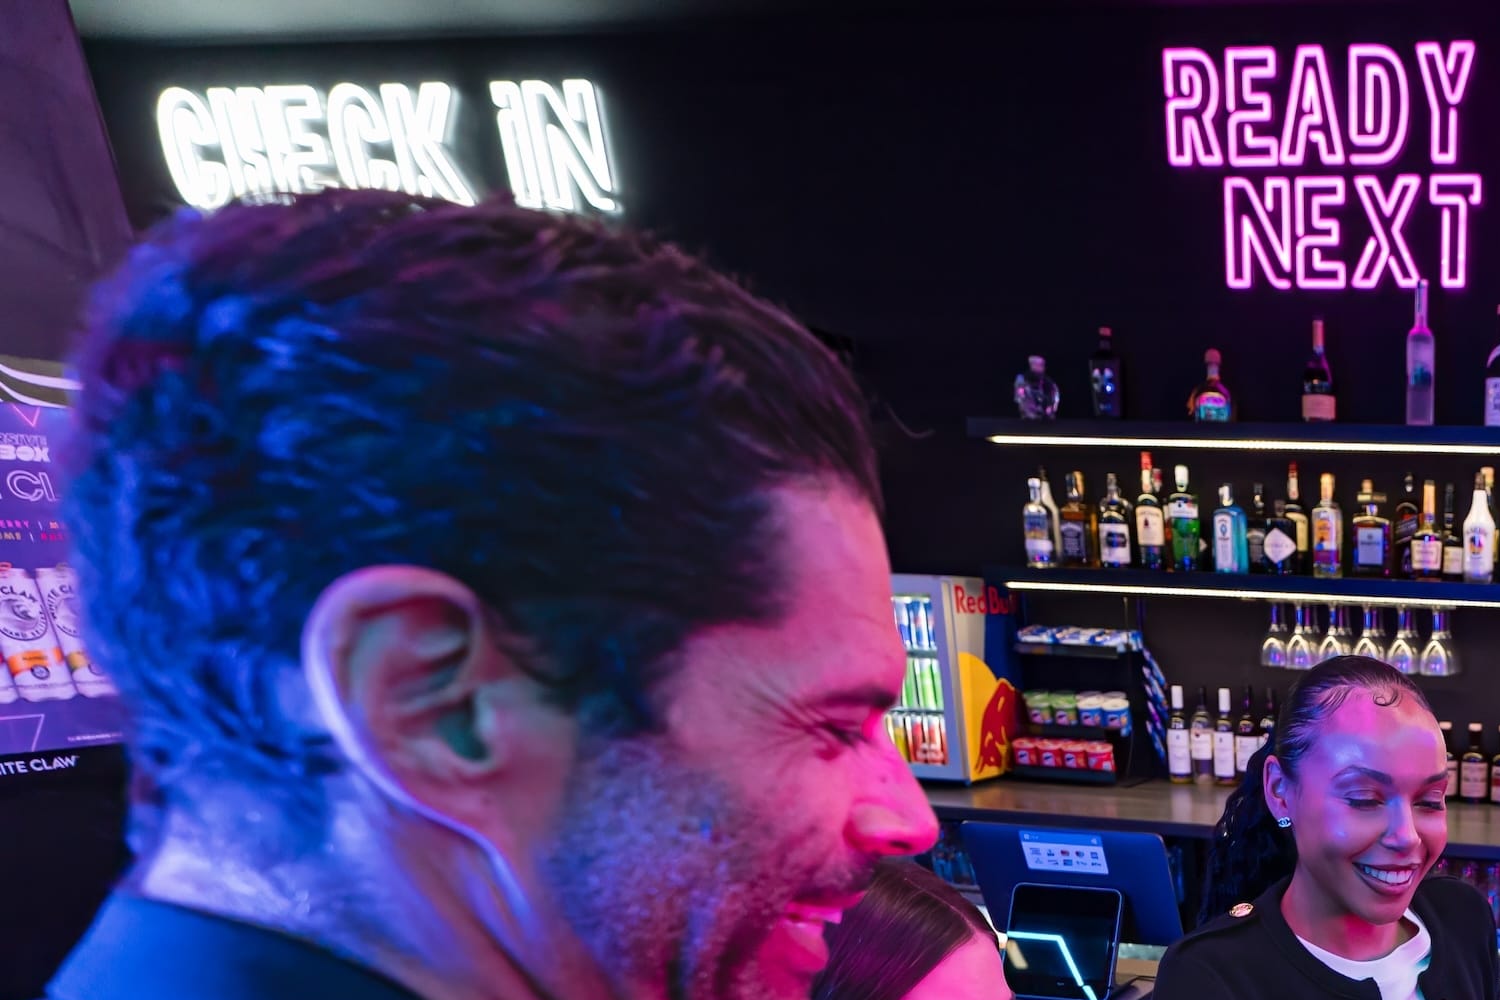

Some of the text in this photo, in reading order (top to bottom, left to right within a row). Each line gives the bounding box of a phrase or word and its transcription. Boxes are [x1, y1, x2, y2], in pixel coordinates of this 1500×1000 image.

[156, 82, 476, 210] CHECK
[1162, 40, 1476, 167] READY
[1223, 174, 1482, 289] NEXT
[953, 584, 986, 614] Red
[0, 760, 28, 776] ITE
